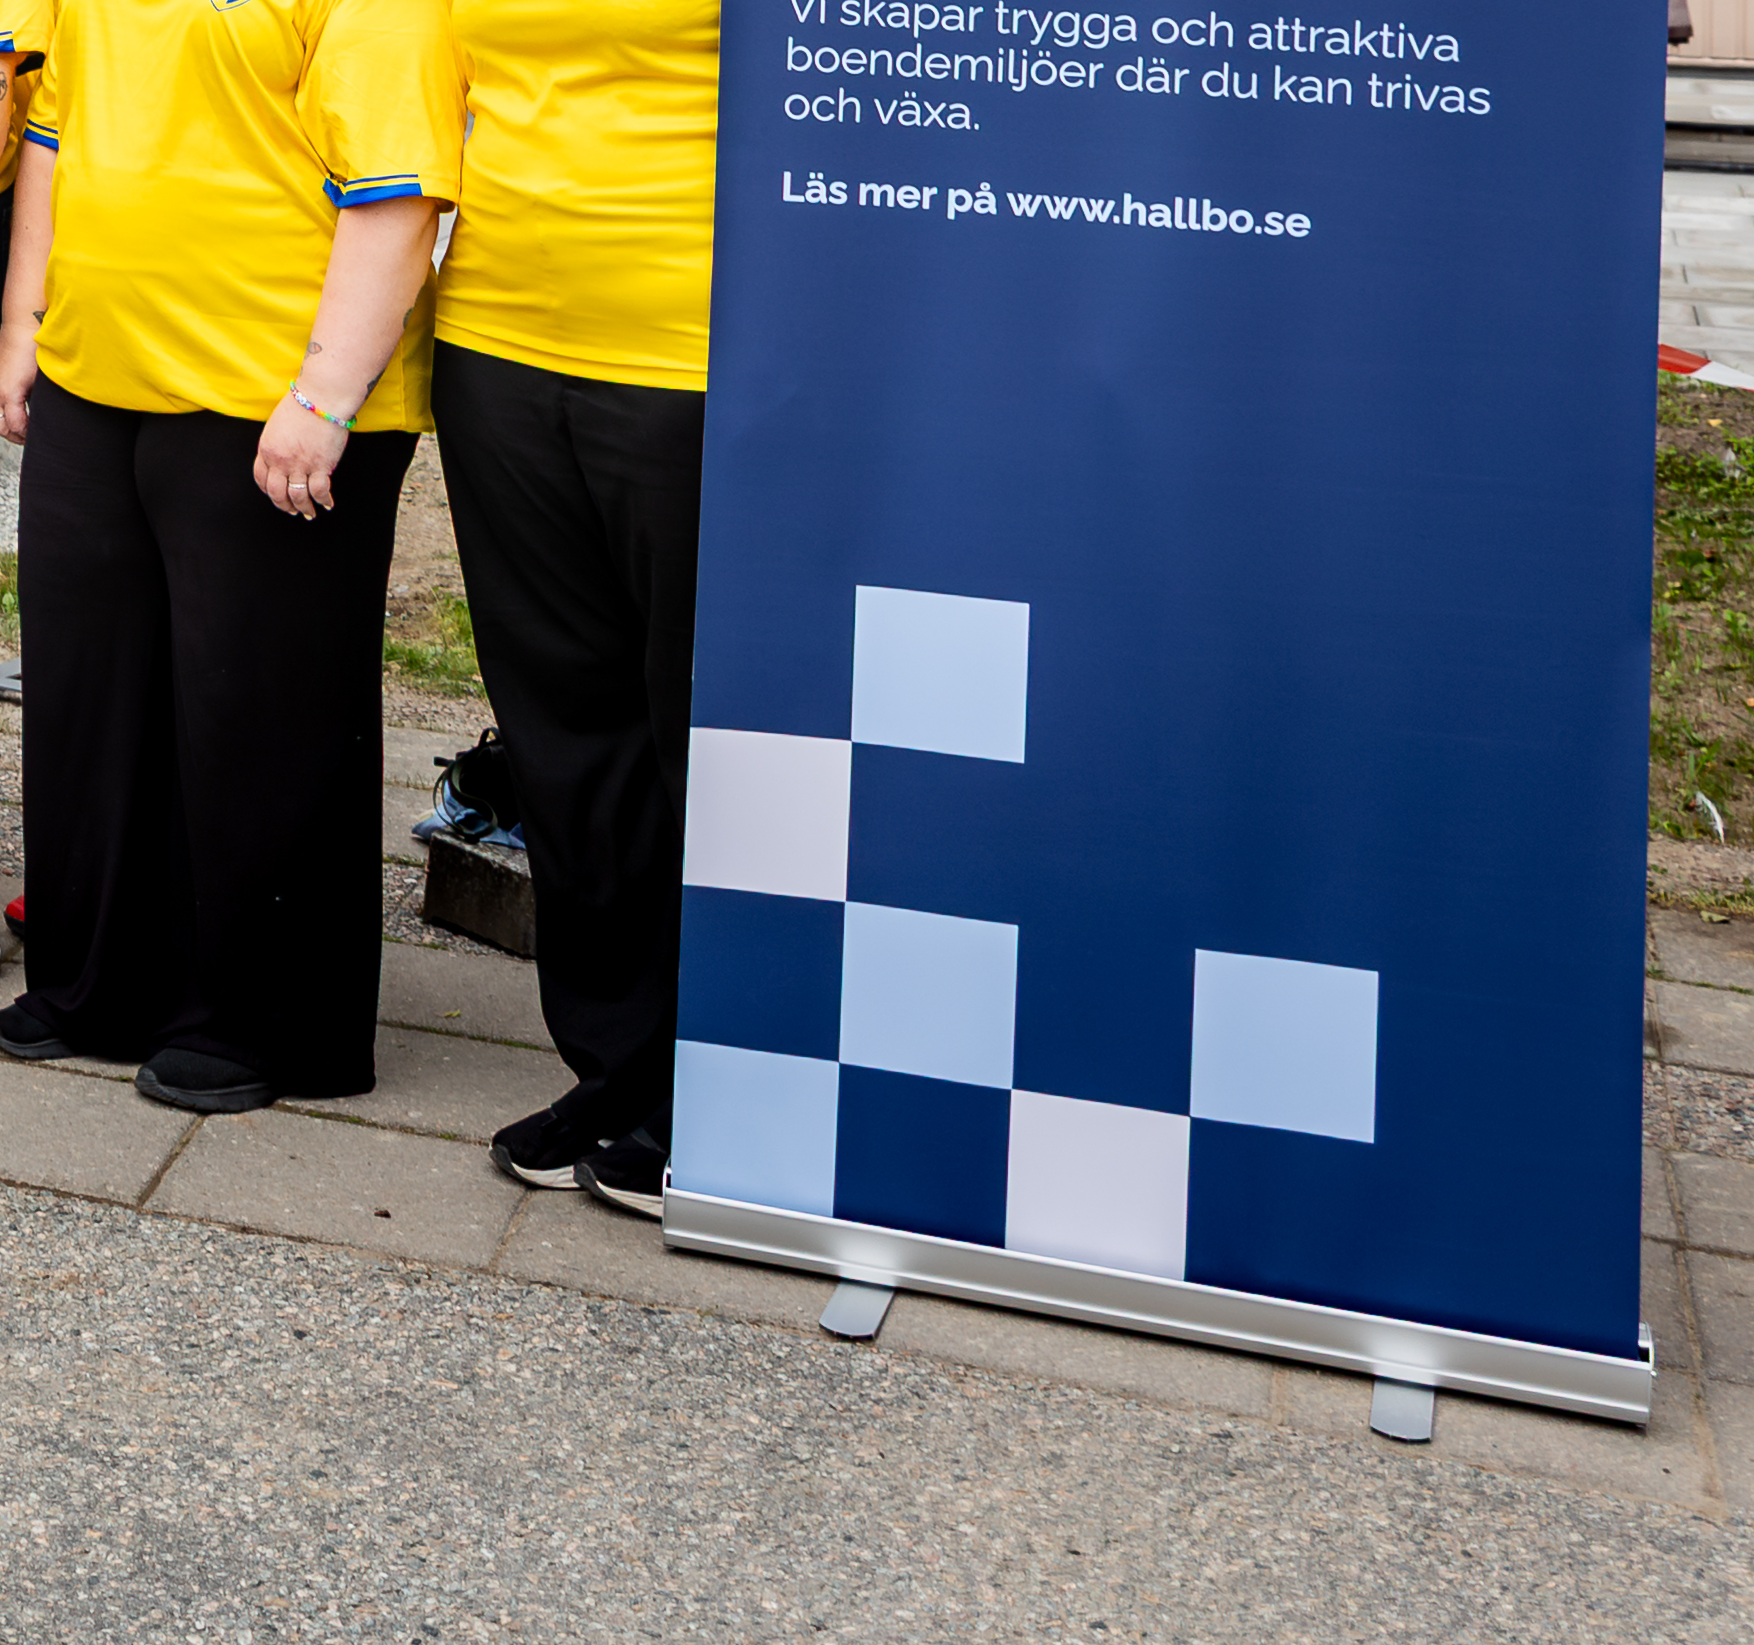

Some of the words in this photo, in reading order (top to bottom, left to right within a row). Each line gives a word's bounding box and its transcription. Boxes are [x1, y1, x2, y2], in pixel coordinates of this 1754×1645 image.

[994, 0, 1137, 49] trygga
[1151, 11, 1234, 48] och
[1248, 16, 1459, 62] attraktiva
[786, 36, 1104, 92] boendemiljöer
[1115, 56, 1190, 95] där
[1201, 61, 1258, 99] du
[1274, 65, 1352, 105] kan
[1367, 73, 1491, 115] trivas
[784, 87, 861, 123] och
[873, 91, 980, 130] växa.
[782, 171, 848, 205] Läs
[858, 182, 938, 210] mer
[947, 182, 997, 220] på
[1006, 192, 1311, 238] www.hallbo.se
